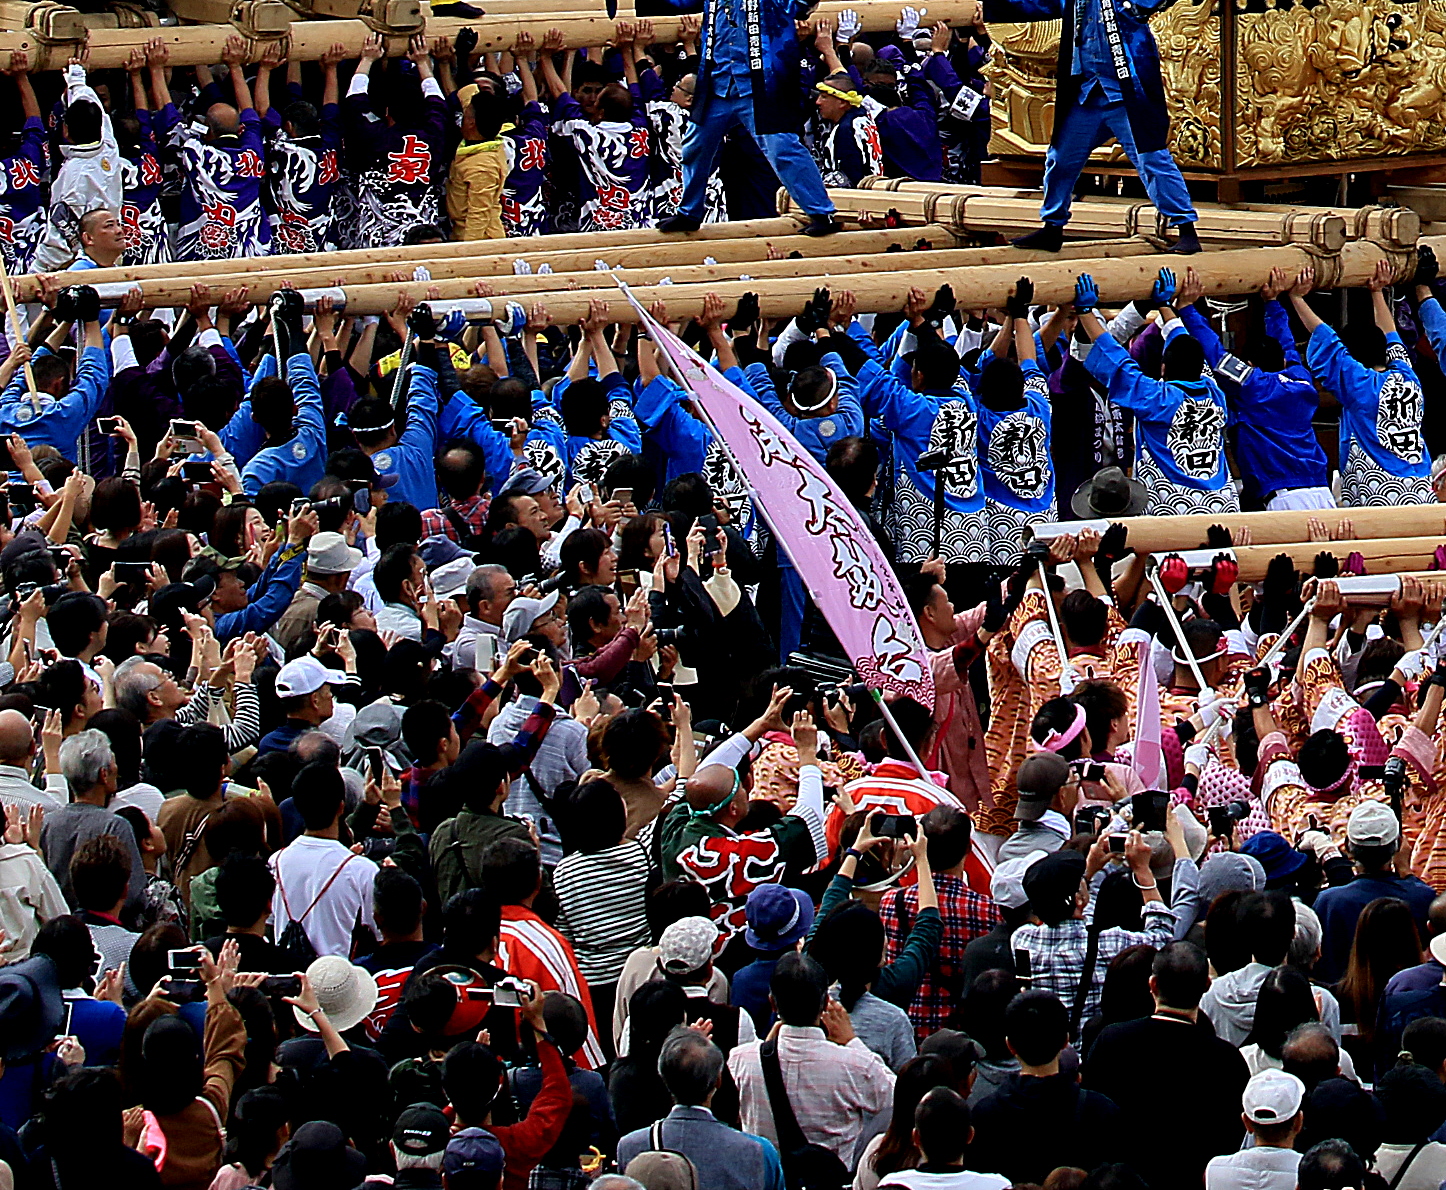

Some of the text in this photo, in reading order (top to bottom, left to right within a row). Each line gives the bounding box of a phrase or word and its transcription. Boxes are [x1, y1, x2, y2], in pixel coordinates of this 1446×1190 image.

[1178, 405, 1222, 470] 新田
[1384, 386, 1420, 451] 新田
[1004, 419, 1043, 491] 新田
